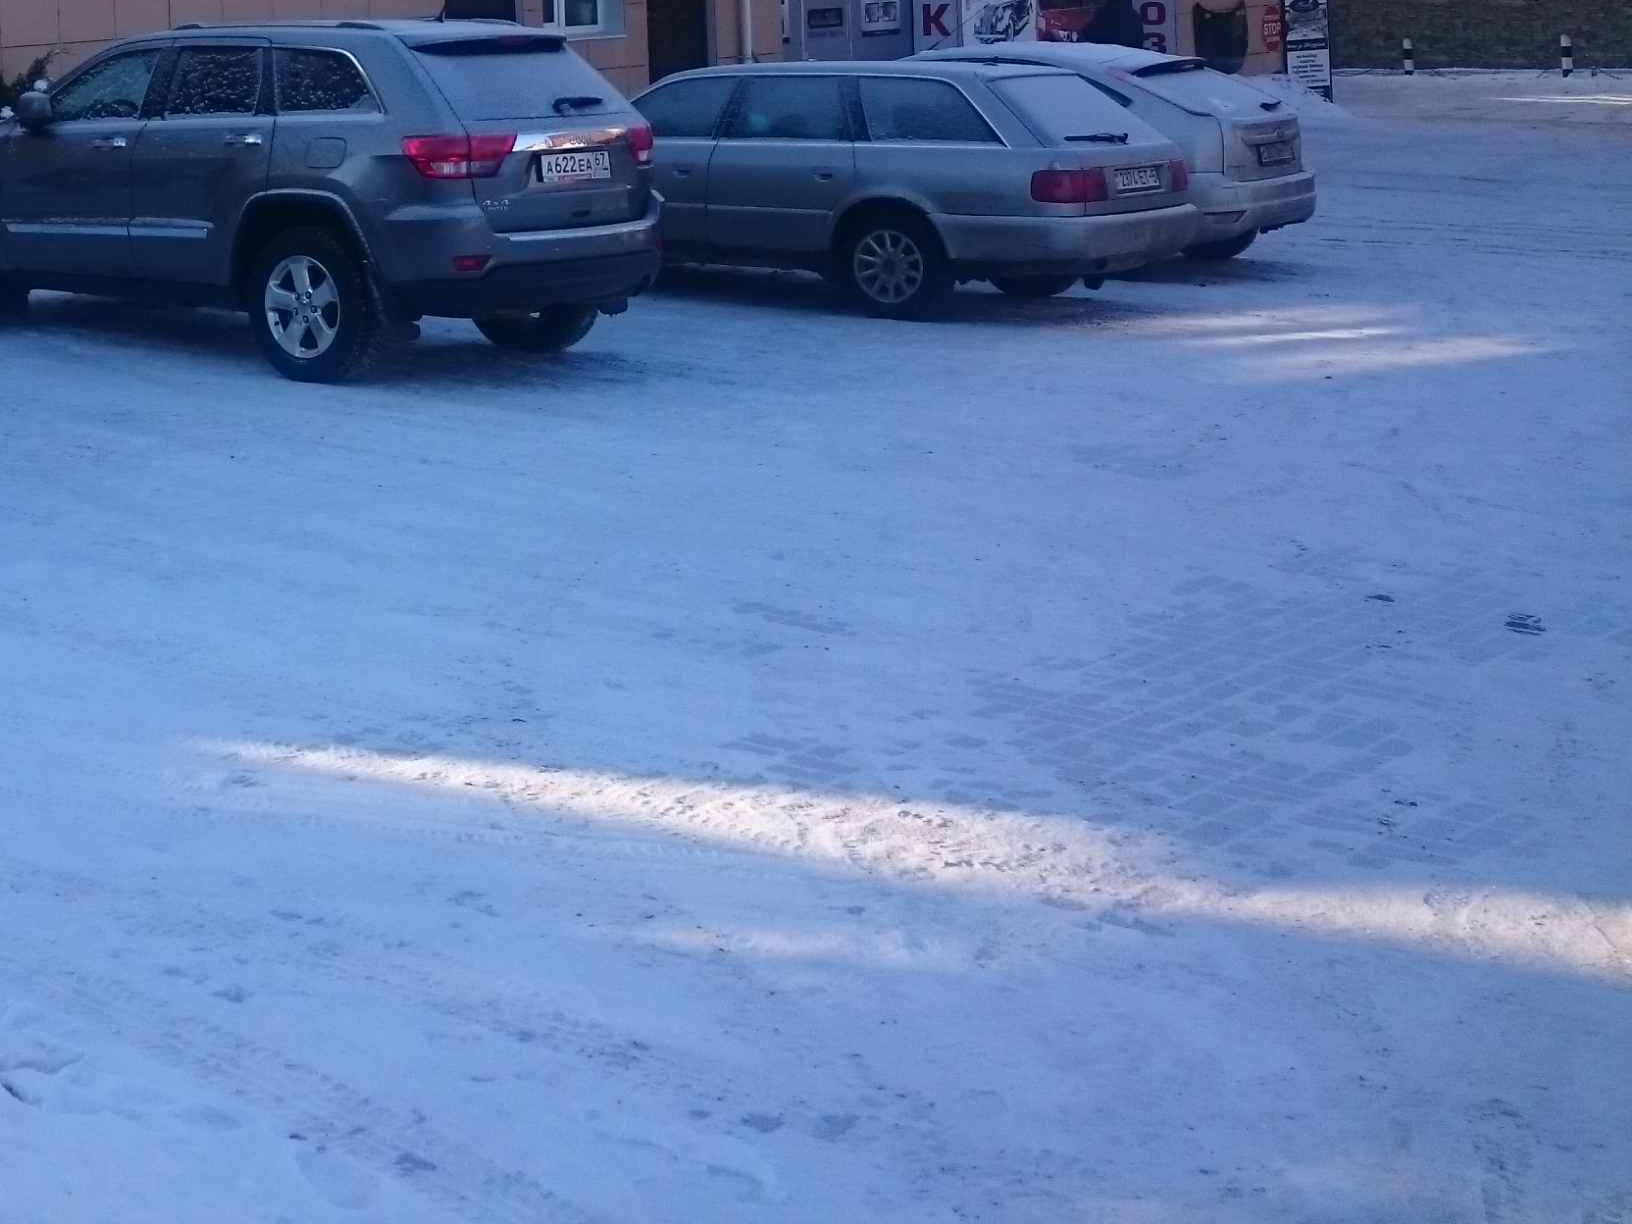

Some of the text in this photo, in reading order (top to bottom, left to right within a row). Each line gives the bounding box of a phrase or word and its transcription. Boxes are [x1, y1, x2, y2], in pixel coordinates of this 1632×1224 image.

[1263, 22, 1281, 35] STOP
[547, 152, 605, 175] А622ЕА 67
